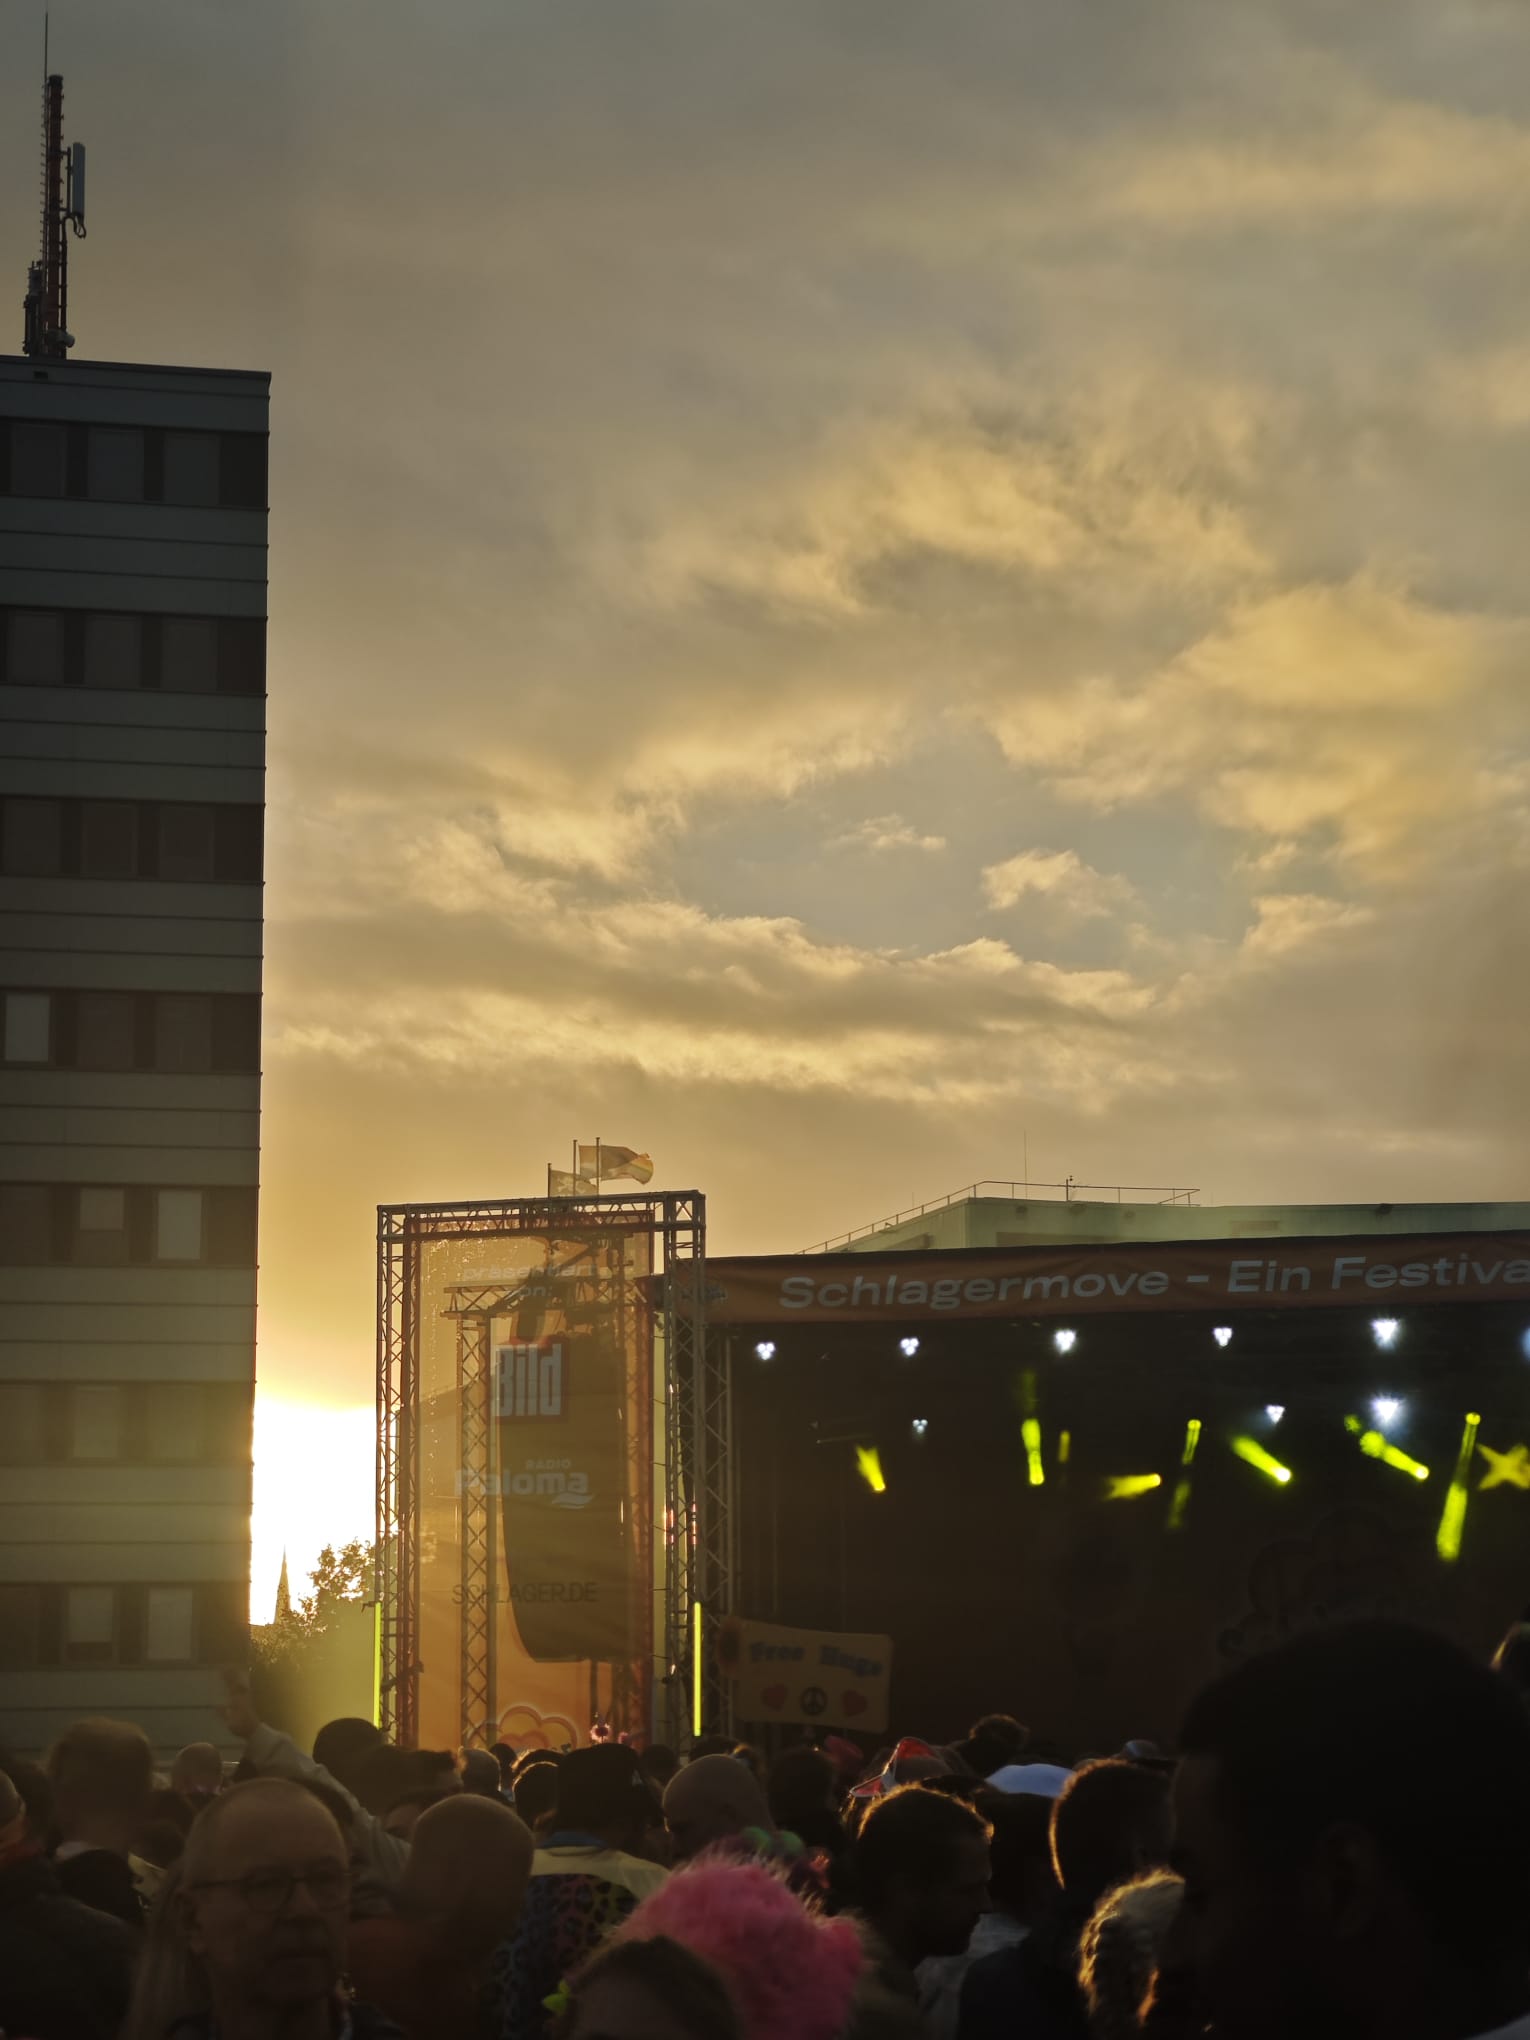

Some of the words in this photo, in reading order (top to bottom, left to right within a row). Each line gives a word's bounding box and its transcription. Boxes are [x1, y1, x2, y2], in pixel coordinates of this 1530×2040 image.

[780, 1269, 1170, 1311] Schlagermove
[1227, 1257, 1311, 1294] Ein
[1331, 1252, 1530, 1291] Festiva
[495, 1343, 561, 1417] Bild
[454, 1468, 589, 1496] Paloma
[525, 1458, 572, 1470] RADIO
